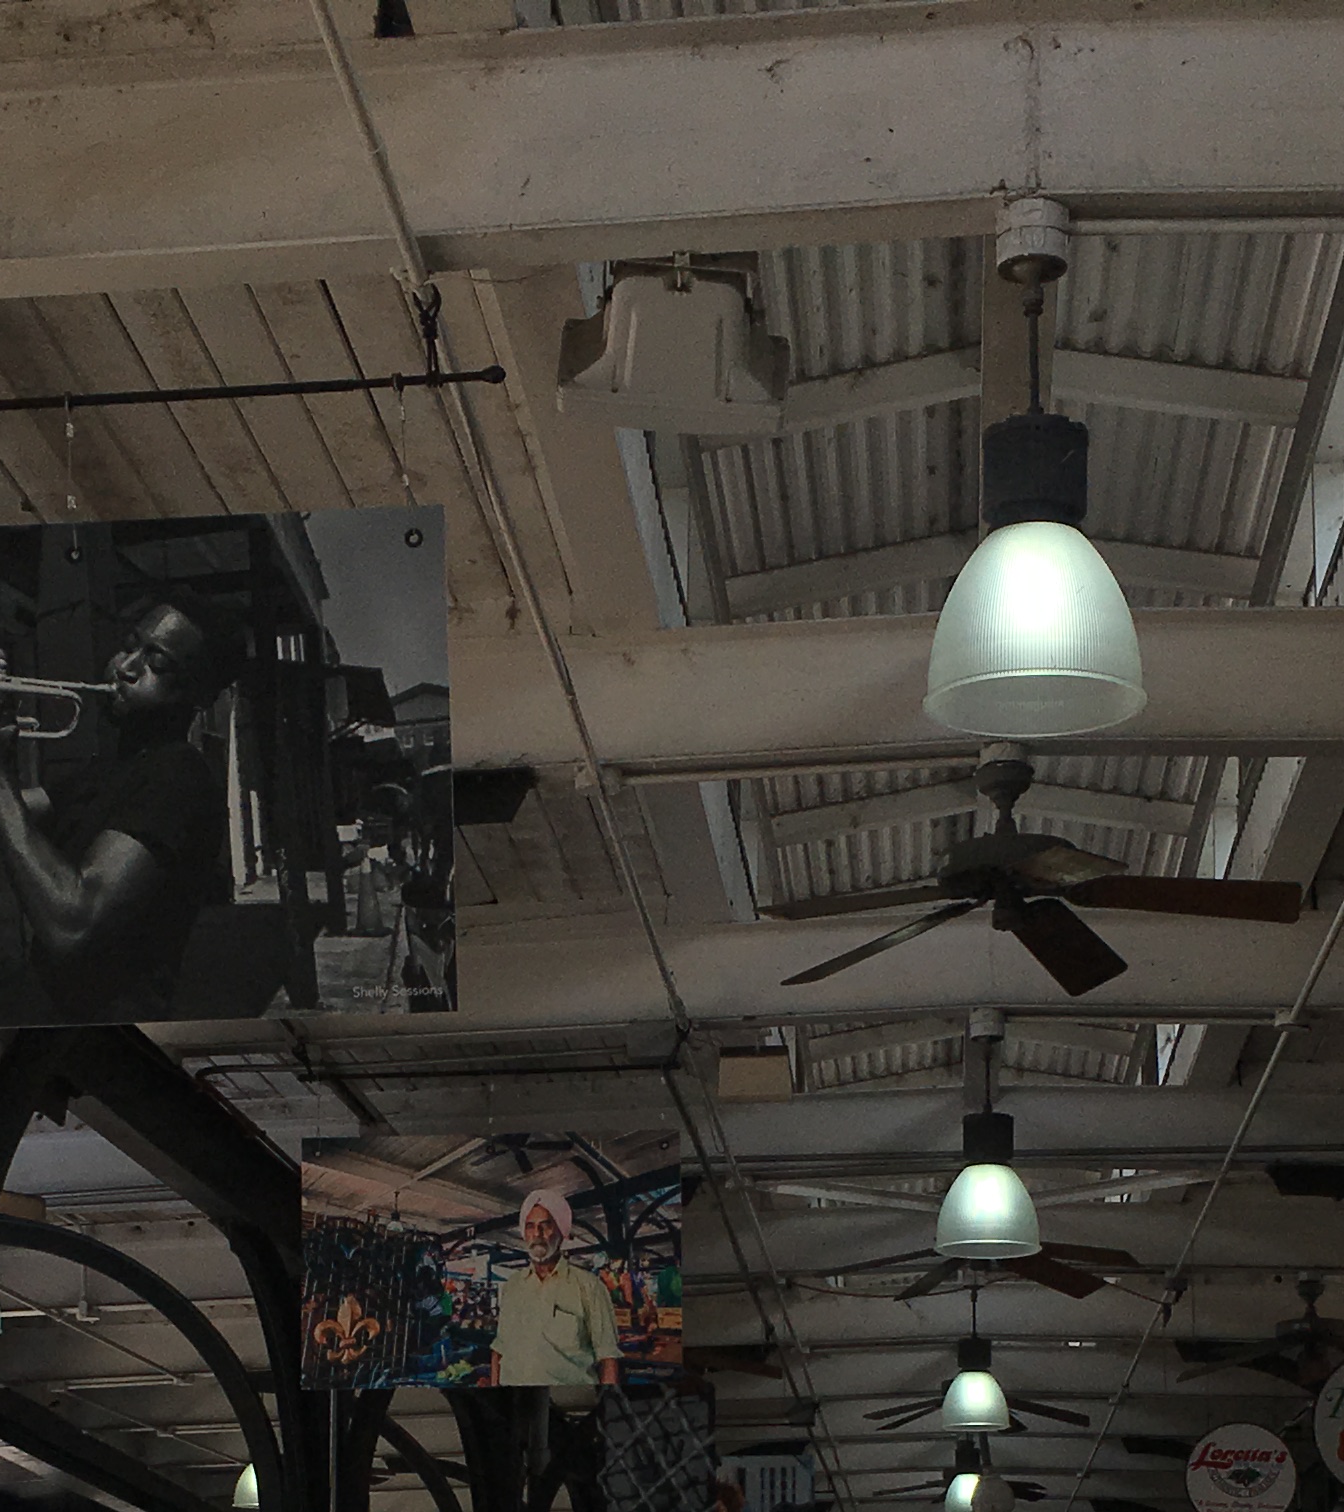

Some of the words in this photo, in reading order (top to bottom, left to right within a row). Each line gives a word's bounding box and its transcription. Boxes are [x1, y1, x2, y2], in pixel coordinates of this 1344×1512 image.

[352, 985, 389, 1001] Shelly
[391, 984, 443, 997] Sessions
[1189, 1442, 1288, 1471] Loretta's
